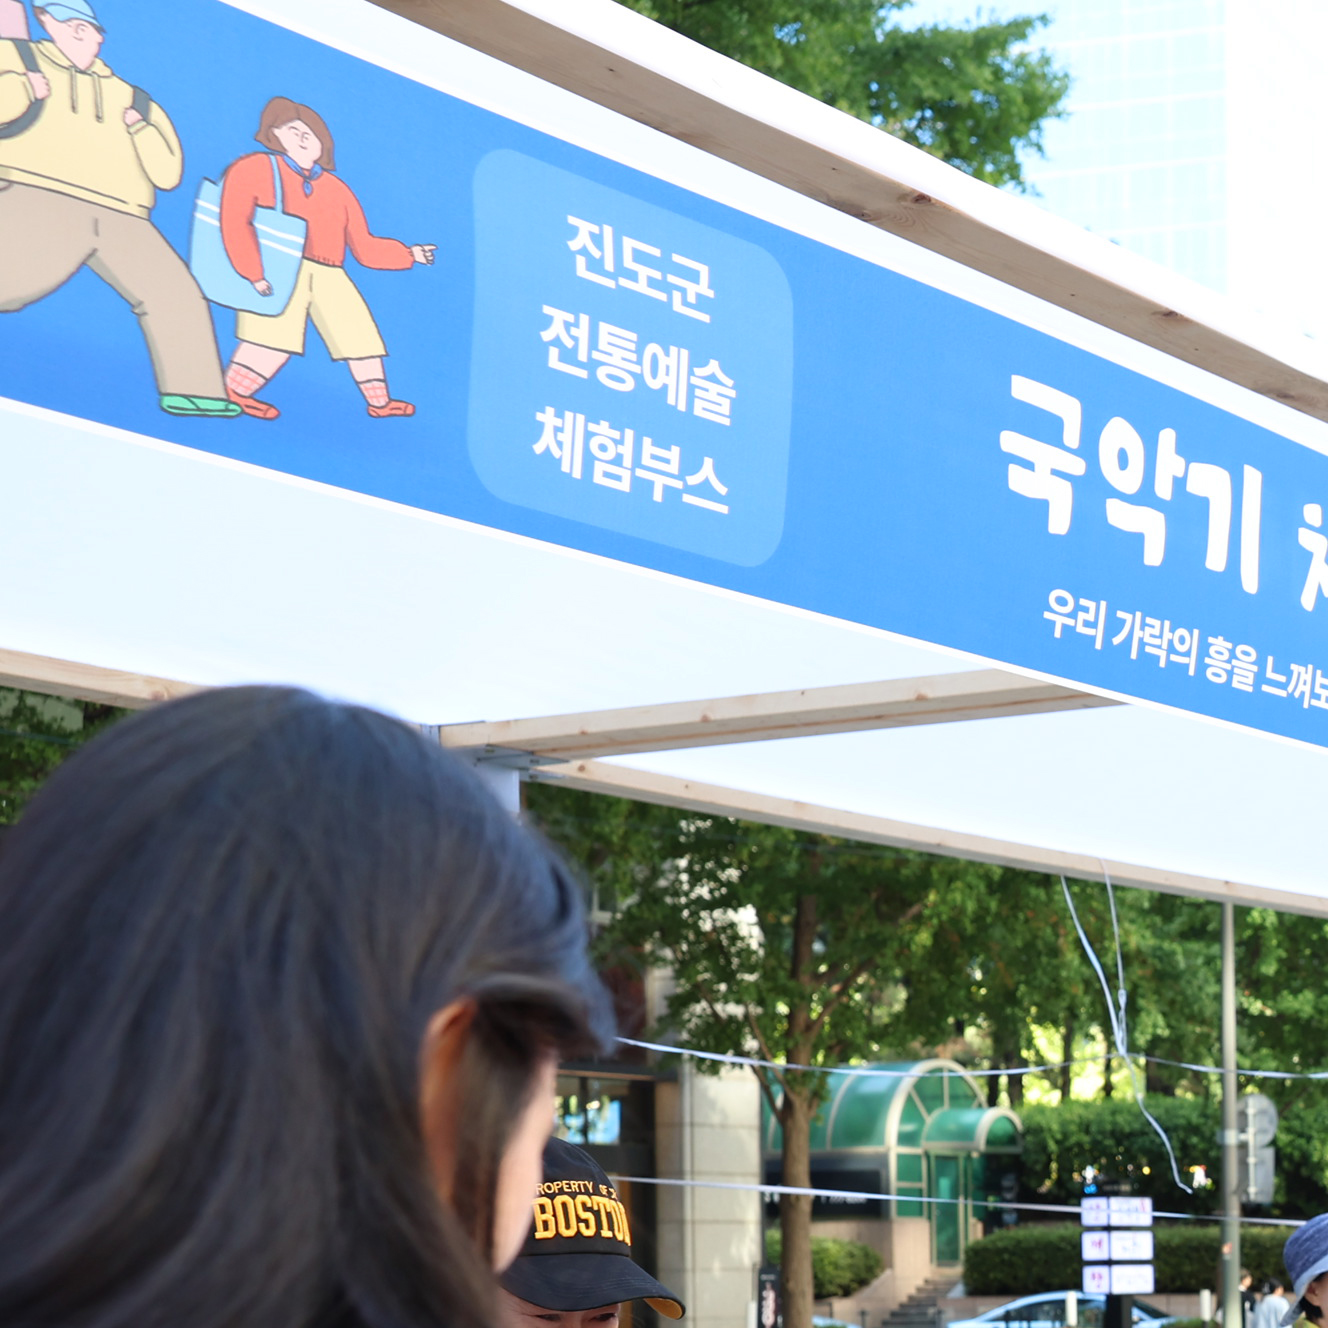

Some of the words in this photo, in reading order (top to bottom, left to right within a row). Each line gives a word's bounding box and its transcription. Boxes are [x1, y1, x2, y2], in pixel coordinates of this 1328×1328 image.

[564, 213, 717, 325] 진도군
[539, 303, 738, 428] 전통예술
[532, 404, 731, 516] 체험부스
[1000, 374, 1262, 594] 국악기
[1043, 588, 1107, 651] 우리
[1112, 609, 1200, 677] 가락의
[1204, 635, 1259, 693] 흥을
[534, 1180, 593, 1196] ROPERTY
